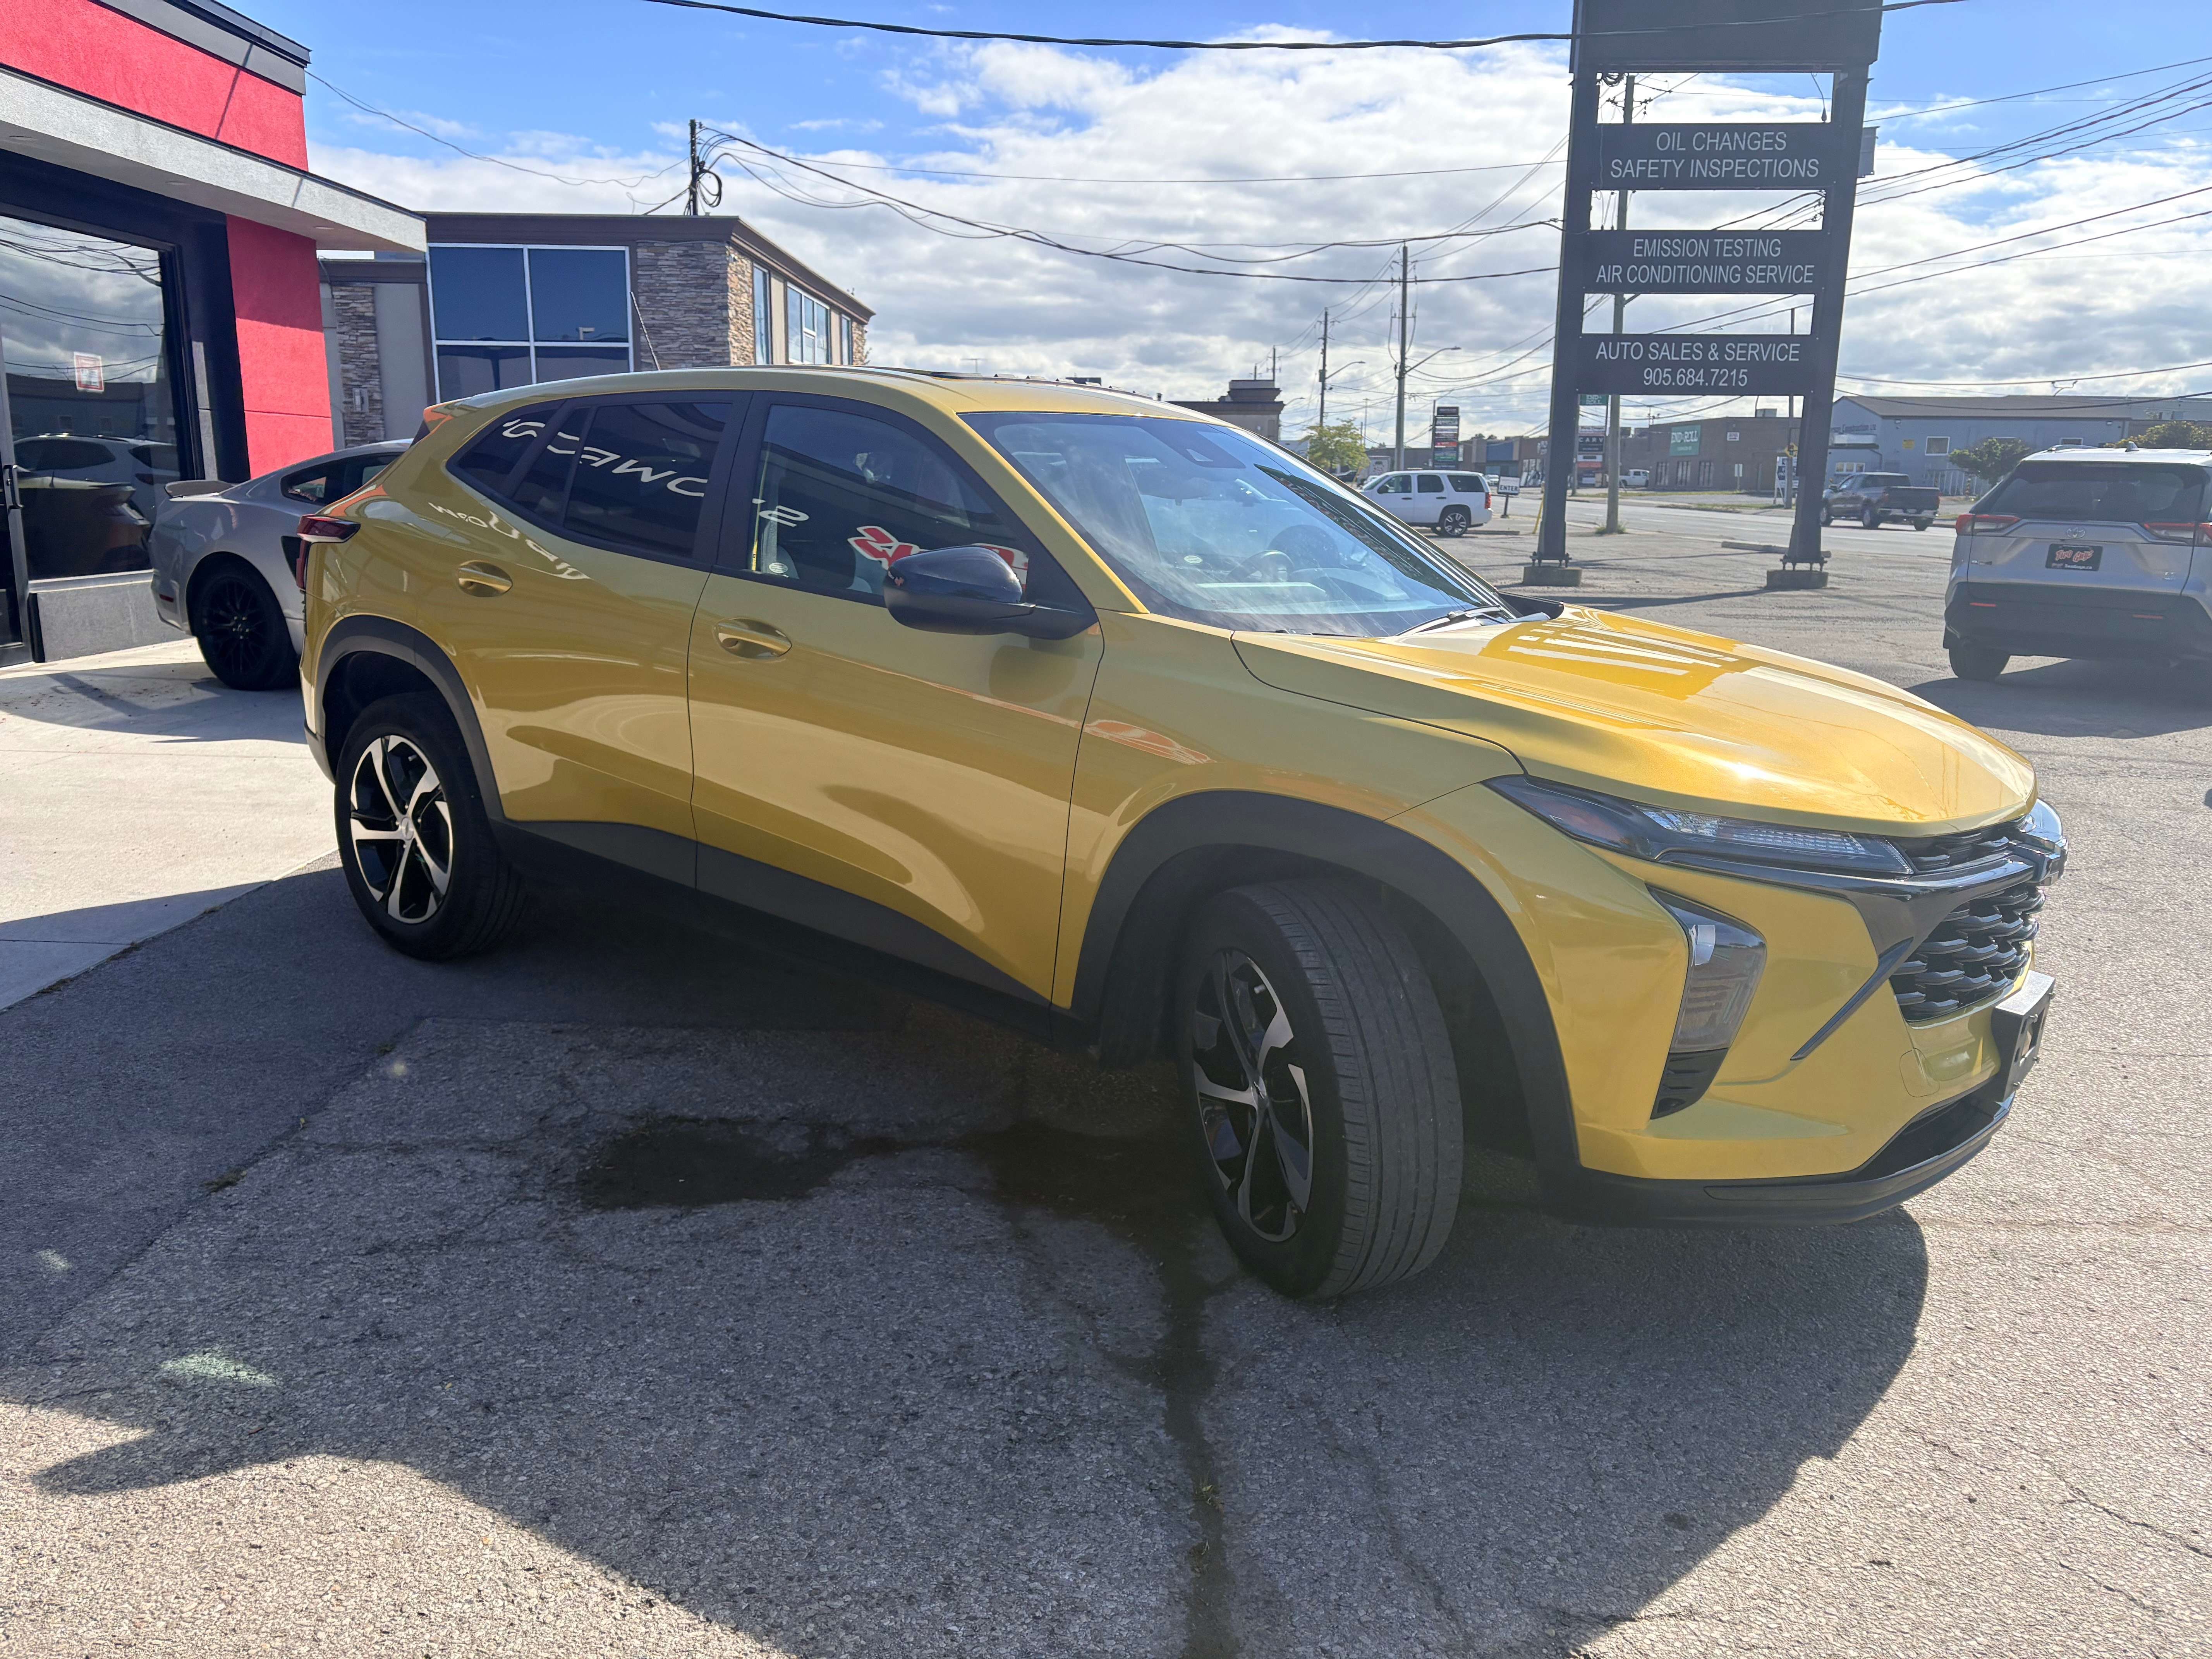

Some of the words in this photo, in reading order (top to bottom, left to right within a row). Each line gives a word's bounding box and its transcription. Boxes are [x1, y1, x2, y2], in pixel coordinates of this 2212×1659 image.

[1656, 132, 1686, 151] OIL
[1693, 131, 1787, 151] CHANGES
[1611, 159, 1685, 178] SAFETY
[1690, 158, 1819, 178] INSPECTIONS
[1633, 239, 1710, 257] EMISSION
[1713, 239, 1781, 257] TESTING
[1596, 265, 1623, 283] AIR
[1626, 265, 1741, 284] CONDITIONING
[1745, 265, 1815, 283] SERVICE
[1595, 342, 1644, 360] AUTO
[1648, 342, 1703, 361] SALES
[1707, 343, 1719, 361] &
[1724, 343, 1801, 361] SERVICE
[1644, 368, 1748, 386] 905.684.7215
